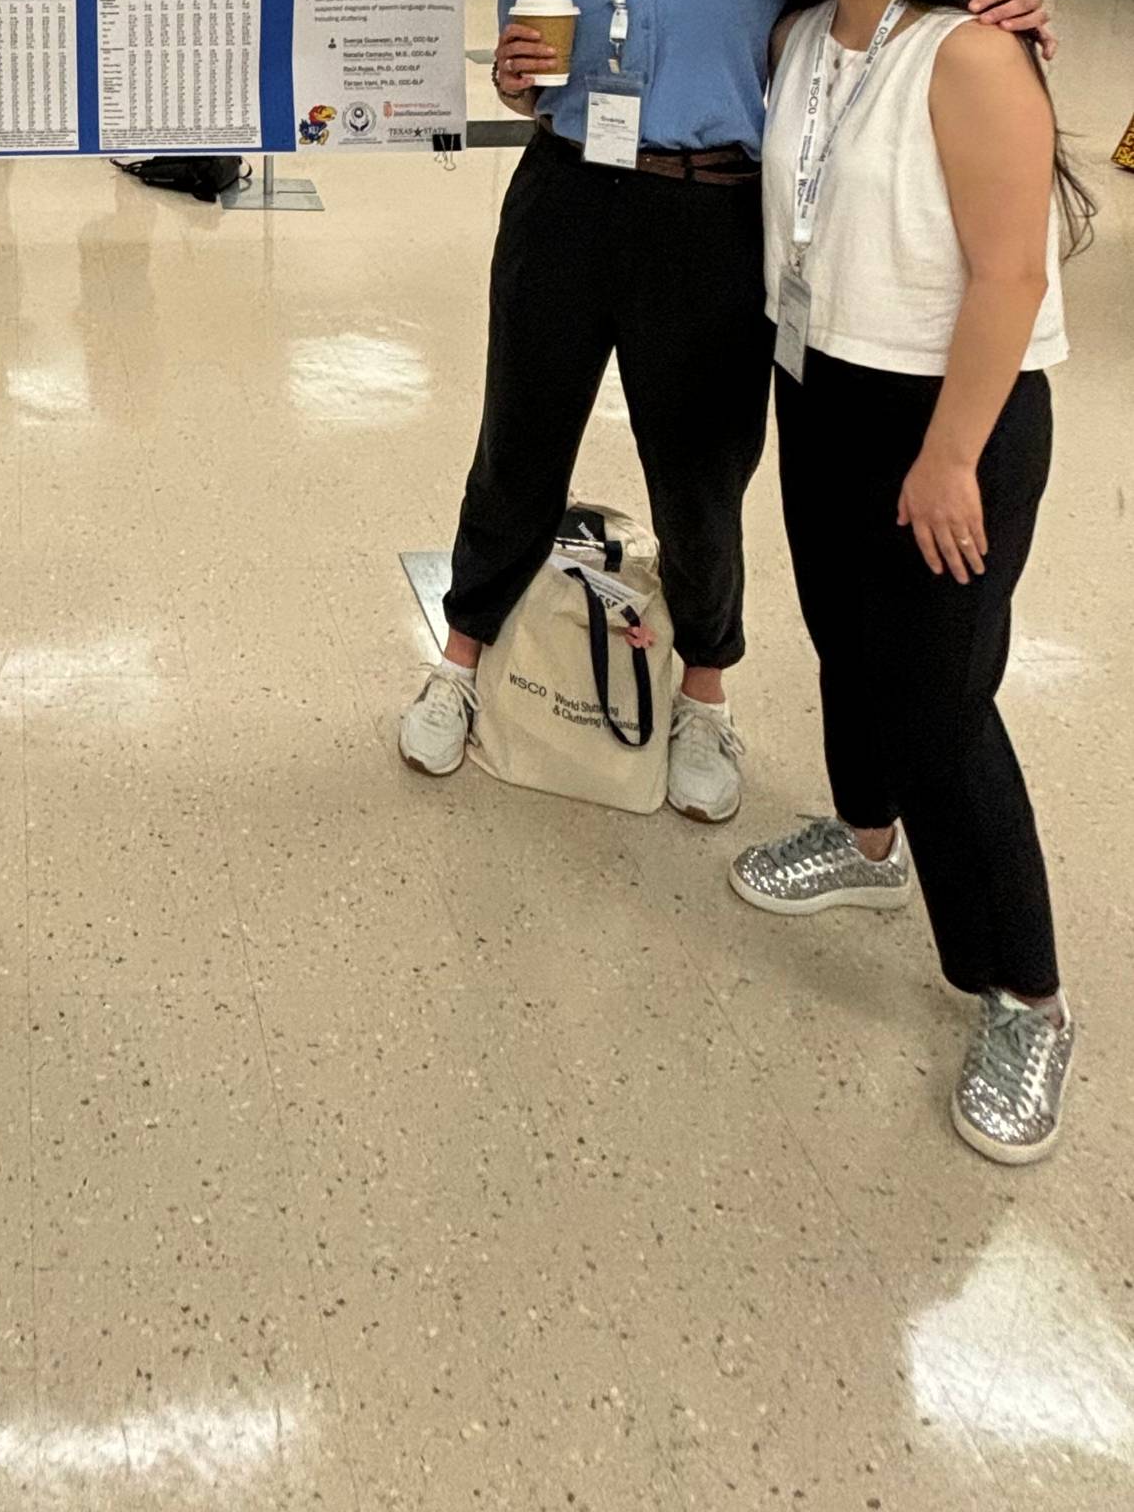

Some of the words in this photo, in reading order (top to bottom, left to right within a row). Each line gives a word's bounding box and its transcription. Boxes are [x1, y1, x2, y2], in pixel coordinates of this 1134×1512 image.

[509, 672, 548, 697] WSCO
[554, 692, 579, 711] World
[552, 704, 561, 715] &
[561, 709, 601, 728] Cluttering
